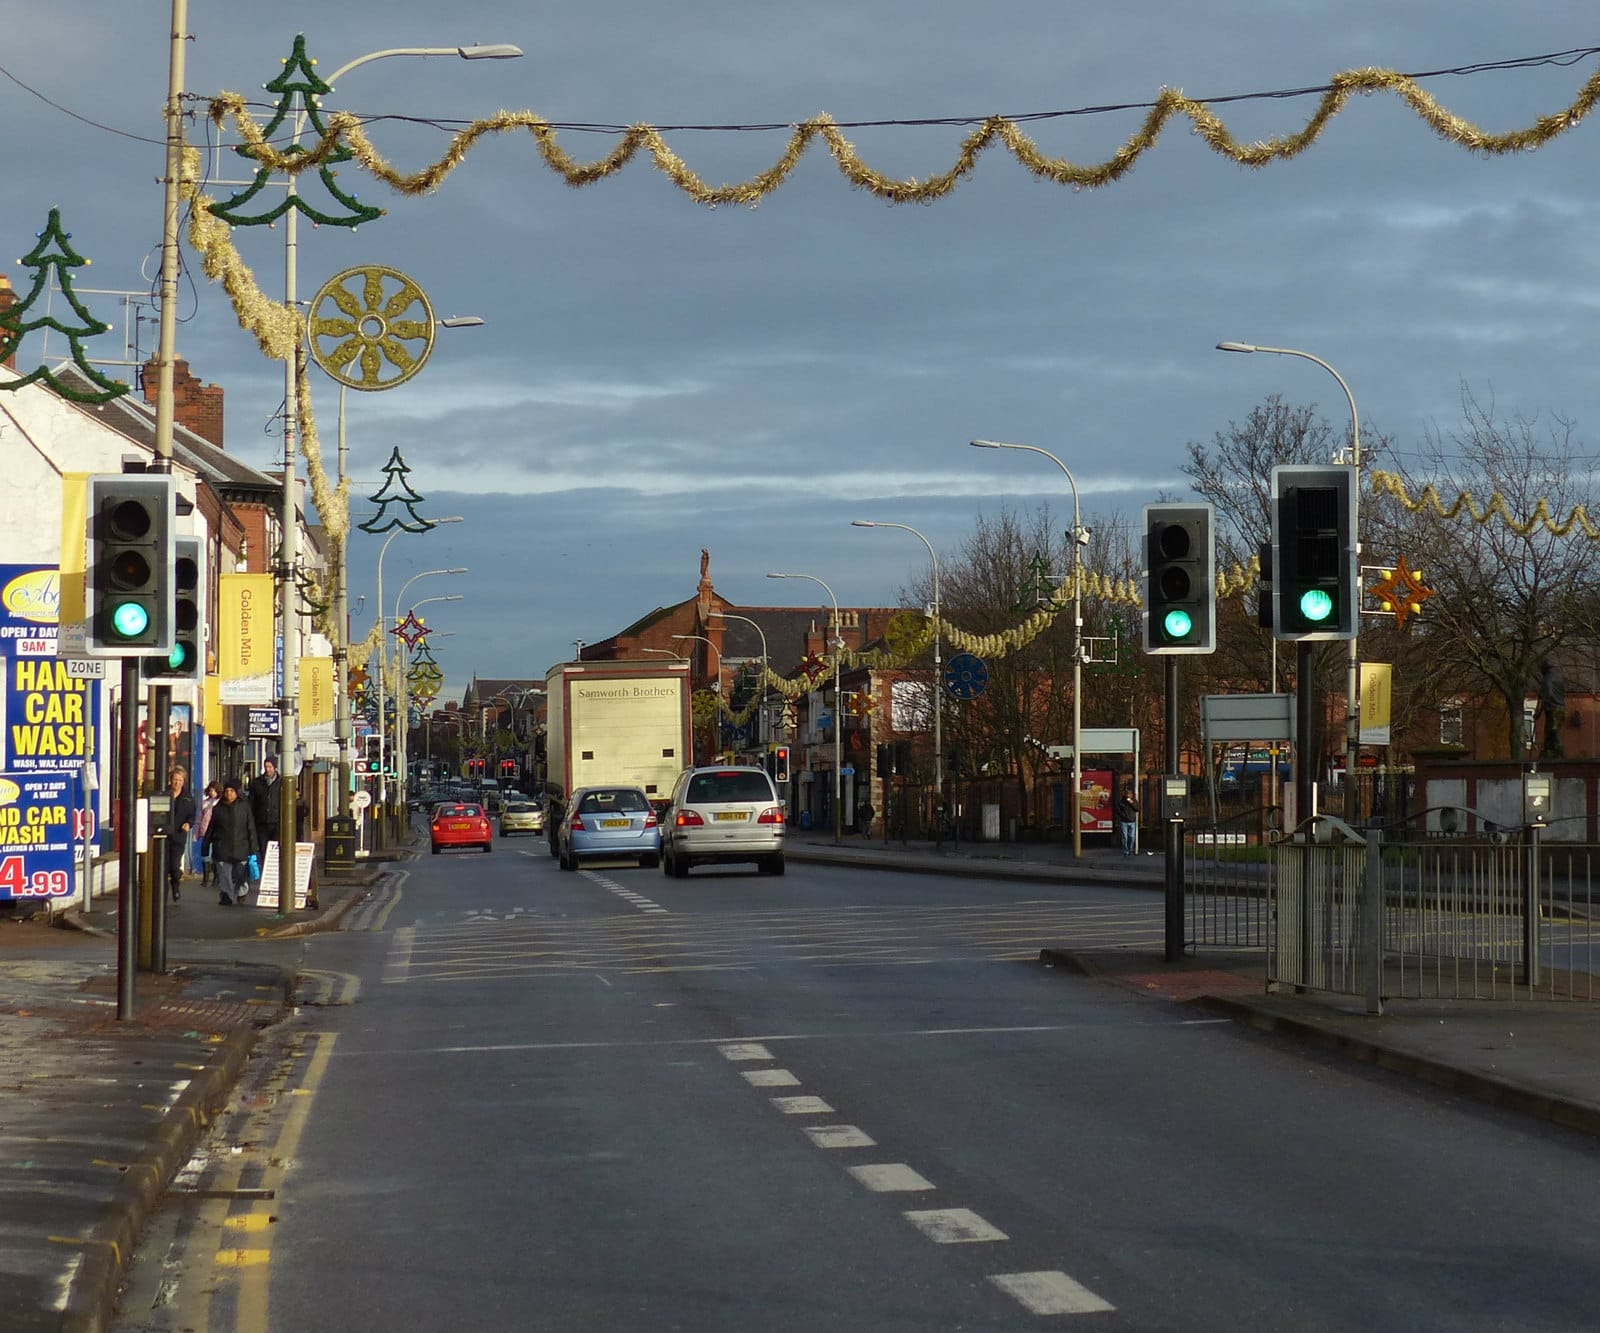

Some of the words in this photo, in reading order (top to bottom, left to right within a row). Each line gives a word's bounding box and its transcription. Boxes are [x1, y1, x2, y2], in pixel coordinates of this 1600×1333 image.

[240, 589, 252, 635] Golden
[0, 627, 28, 638] OPEN
[29, 627, 37, 637] 7
[39, 627, 58, 637] DAY
[22, 641, 46, 652] 9AM
[240, 638, 252, 666] Mile
[71, 662, 101, 674] ZONE
[312, 666, 320, 696] Golden
[579, 688, 628, 698] Samworth
[633, 687, 675, 697] Brothers
[25, 693, 83, 724] CAR
[312, 698, 320, 716] Mile
[12, 725, 95, 756] WASH
[13, 760, 38, 769] WASH,
[39, 760, 58, 769] WAX,
[60, 759, 84, 768] LEATH
[24, 783, 42, 791] OPEN
[49, 782, 66, 790] DAYS
[39, 791, 58, 799] WEEK
[26, 806, 66, 825] CAR
[0, 856, 68, 896] 4.99
